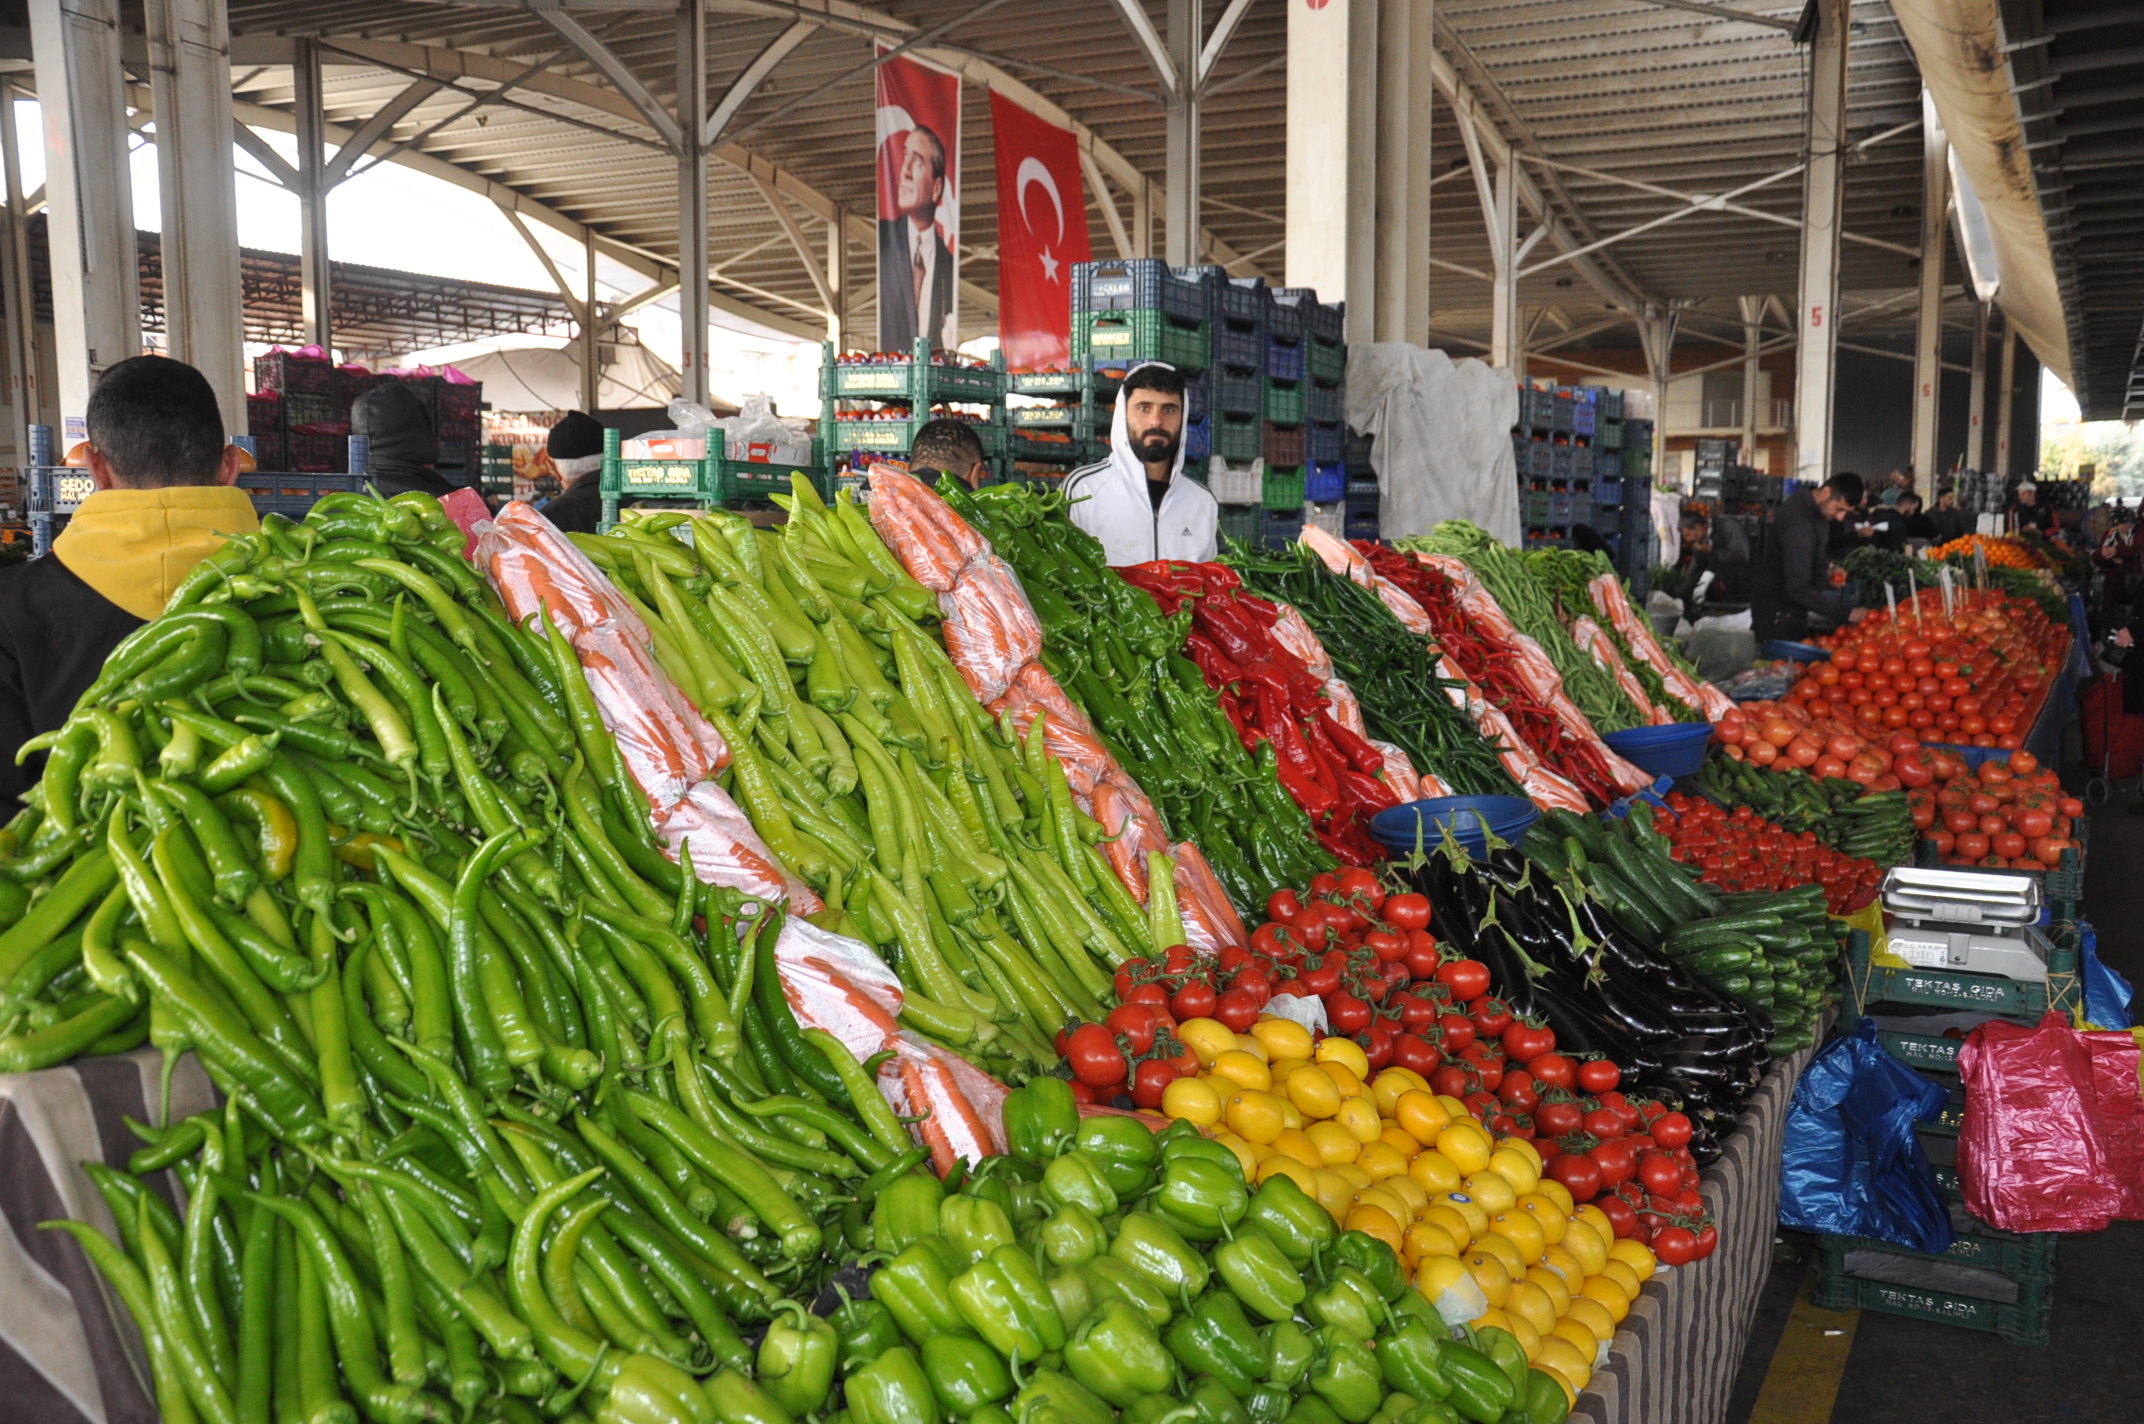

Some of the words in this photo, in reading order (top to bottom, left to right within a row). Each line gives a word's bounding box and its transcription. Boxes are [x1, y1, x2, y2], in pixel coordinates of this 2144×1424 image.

[1812, 307, 1822, 327] 5
[685, 352, 692, 368] 3
[1923, 384, 1930, 397] 5
[60, 479, 95, 493] SEDO
[1906, 977, 1961, 992] TEKTAS
[1971, 984, 2005, 997] GIDA
[1900, 1041, 1955, 1056] TEKTAS
[1880, 1289, 1934, 1306] TEKTAS
